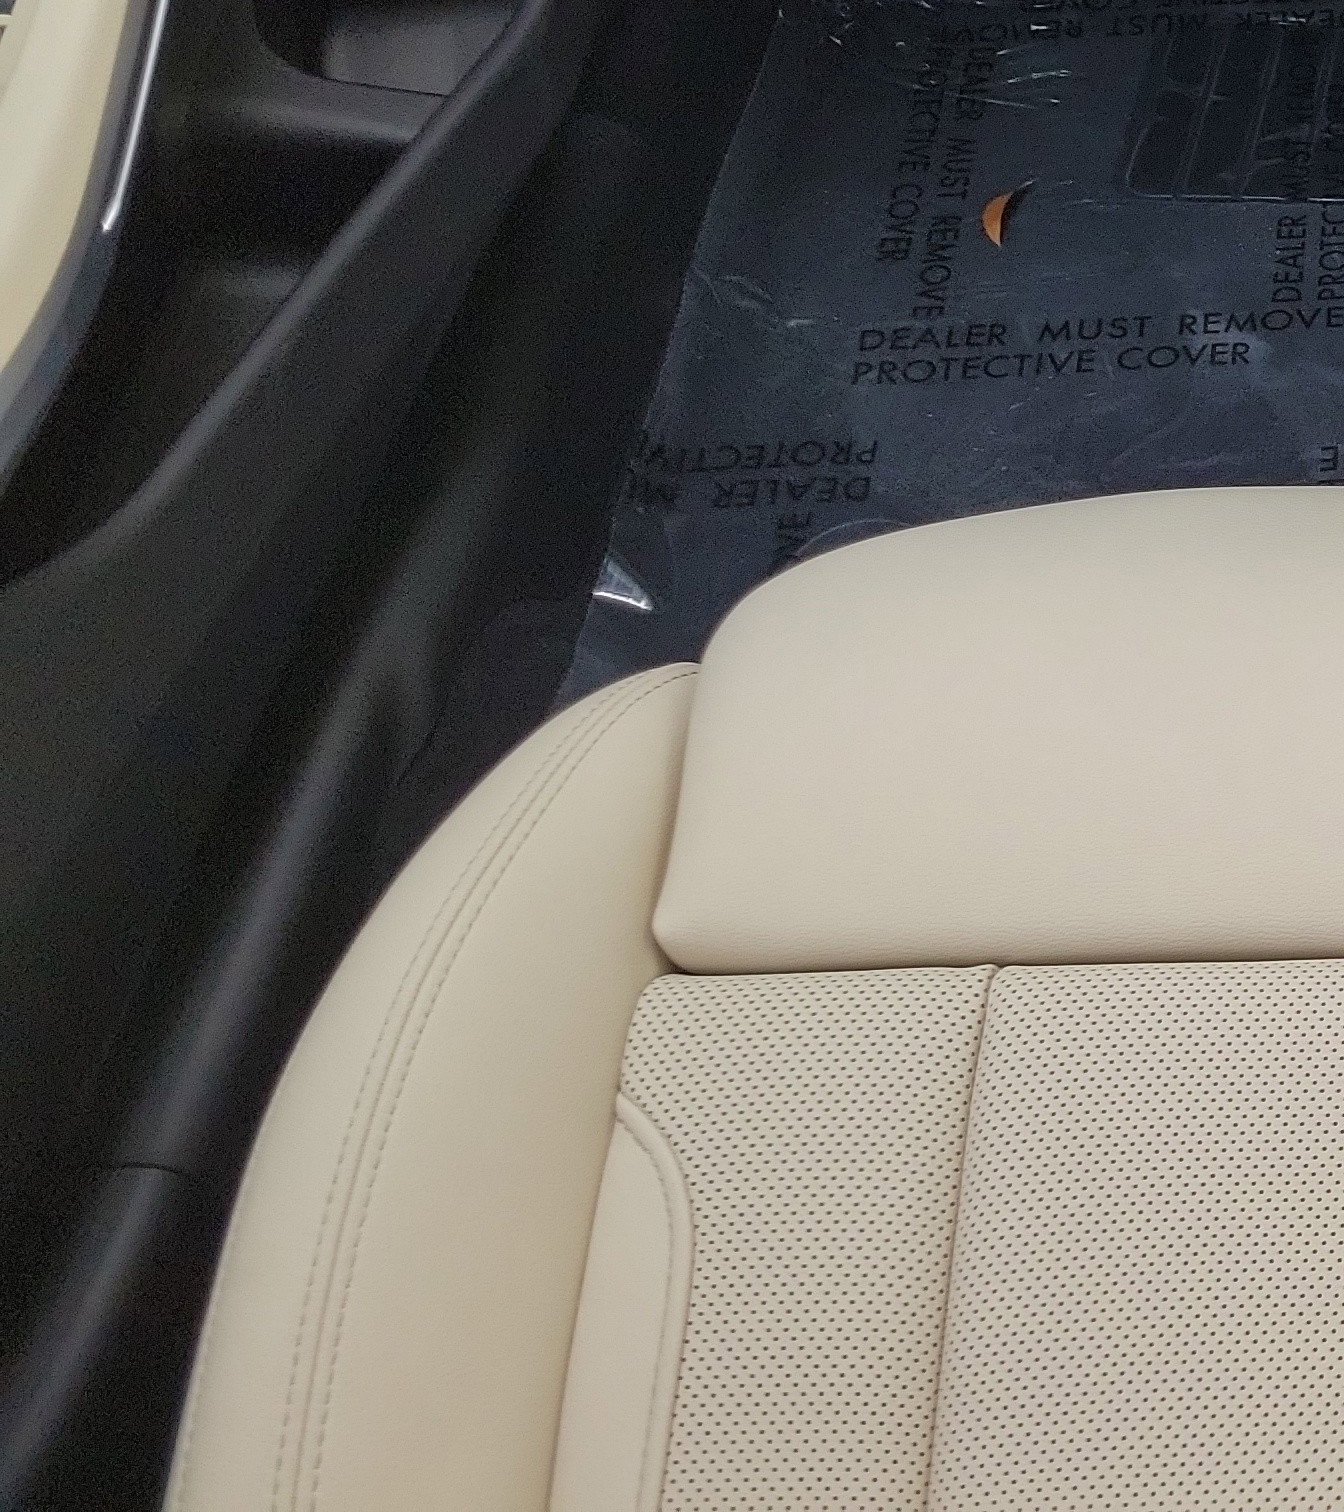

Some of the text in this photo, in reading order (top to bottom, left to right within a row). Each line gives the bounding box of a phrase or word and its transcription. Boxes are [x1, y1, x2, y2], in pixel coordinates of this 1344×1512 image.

[1106, 14, 1208, 38] MUST
[876, 183, 925, 262] COVER
[913, 137, 977, 319] MUST REMOVE
[1271, 214, 1308, 304] DEALER
[857, 321, 1008, 353] DEALER
[1037, 315, 1153, 345] MUST
[851, 342, 1251, 386] PROTECTIVE COVER
[711, 476, 872, 509] DEALER
